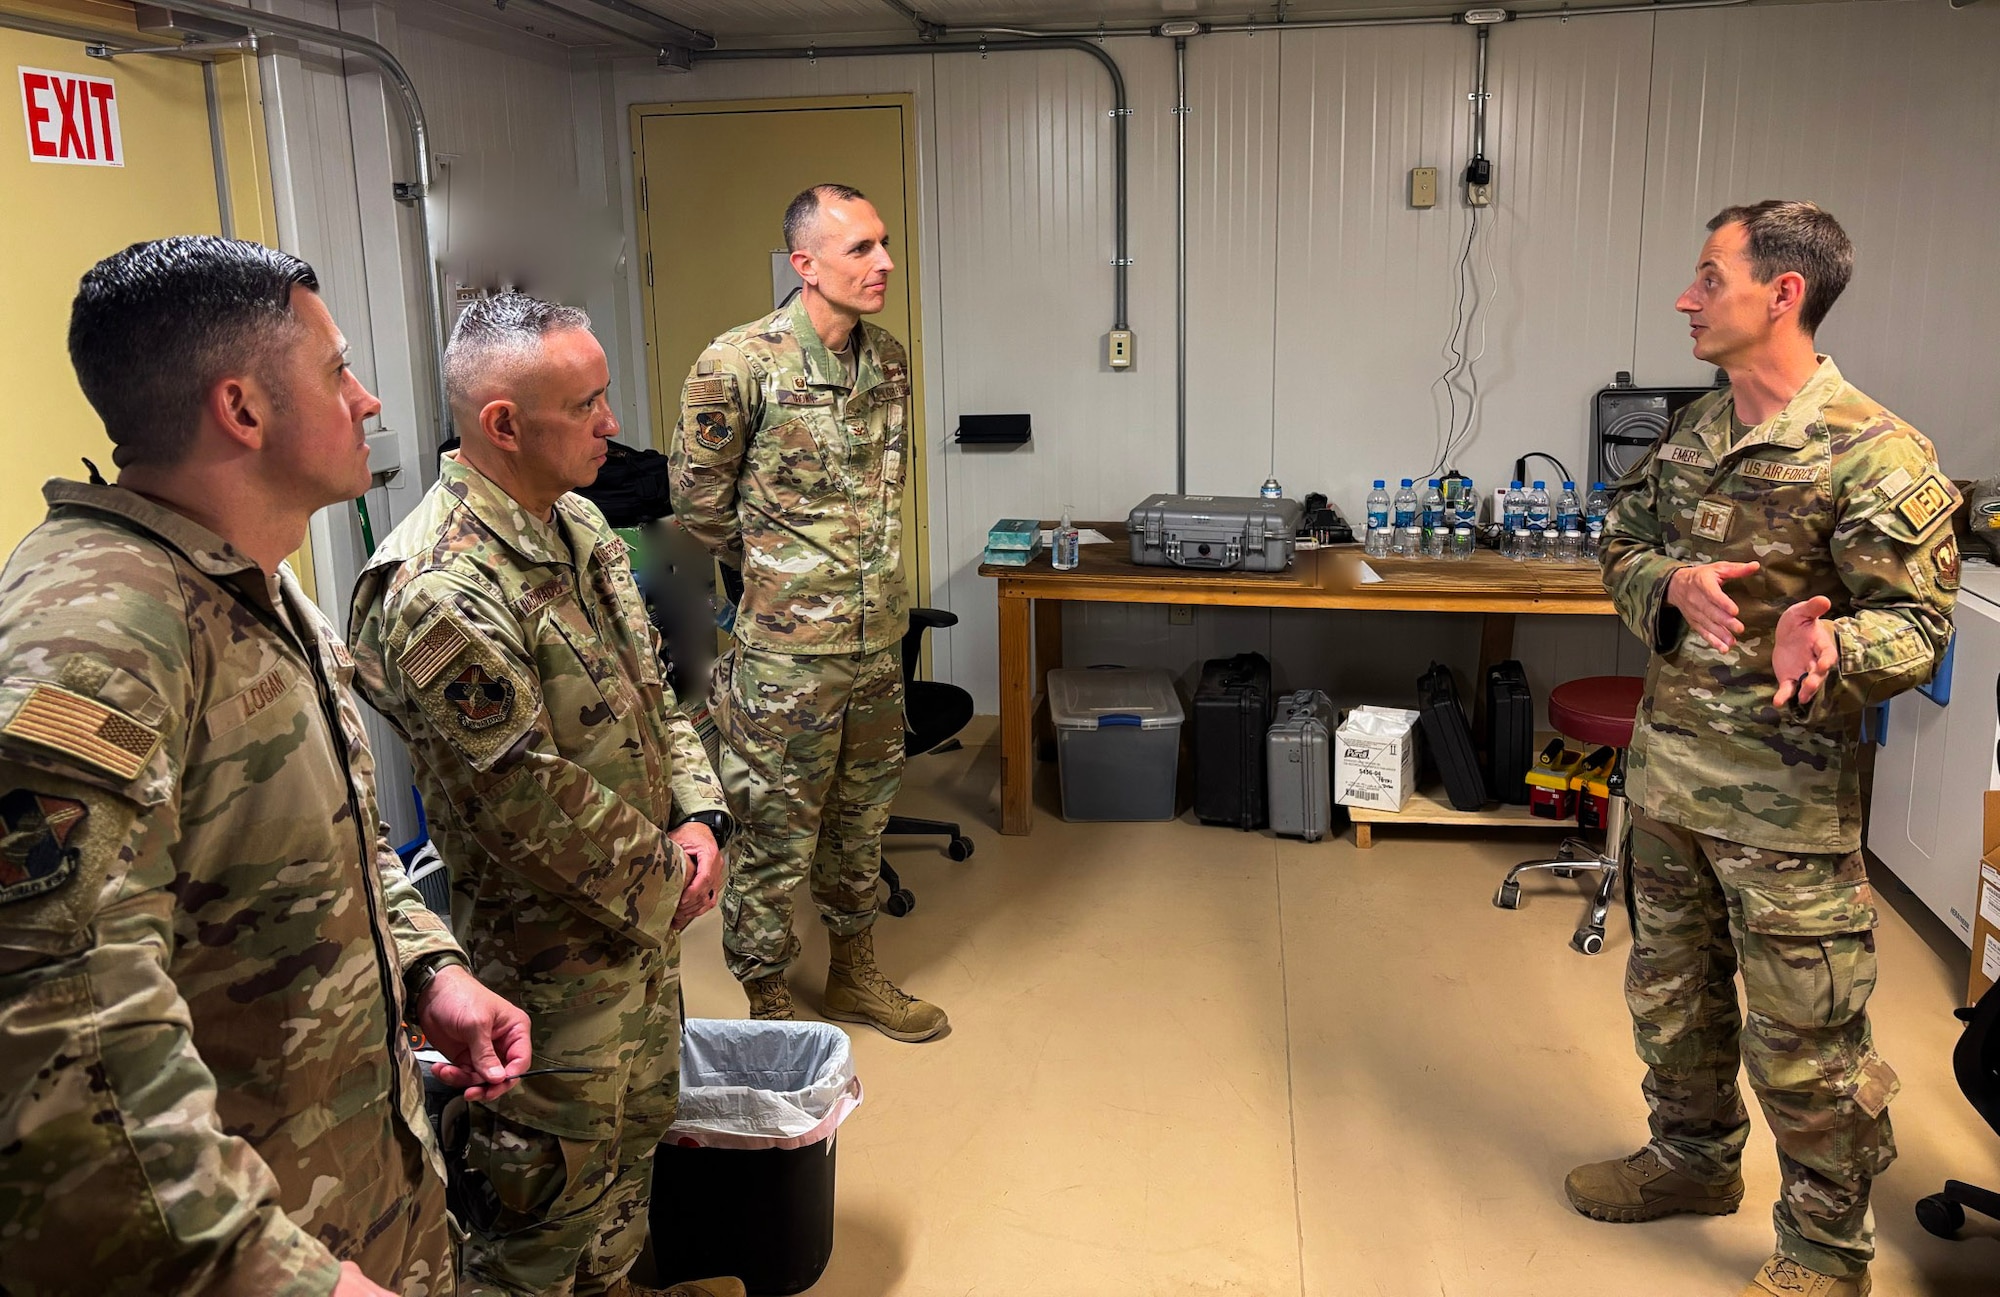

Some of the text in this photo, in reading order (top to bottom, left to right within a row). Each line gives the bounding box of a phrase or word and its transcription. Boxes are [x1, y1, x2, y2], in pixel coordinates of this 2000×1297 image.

[23, 72, 114, 161] EXIT
[1671, 447, 1702, 463] EMERY
[1764, 466, 1782, 479] AIR
[1783, 467, 1816, 480] FORCE
[1903, 485, 1944, 527] MED
[242, 669, 287, 716] LOGAN
